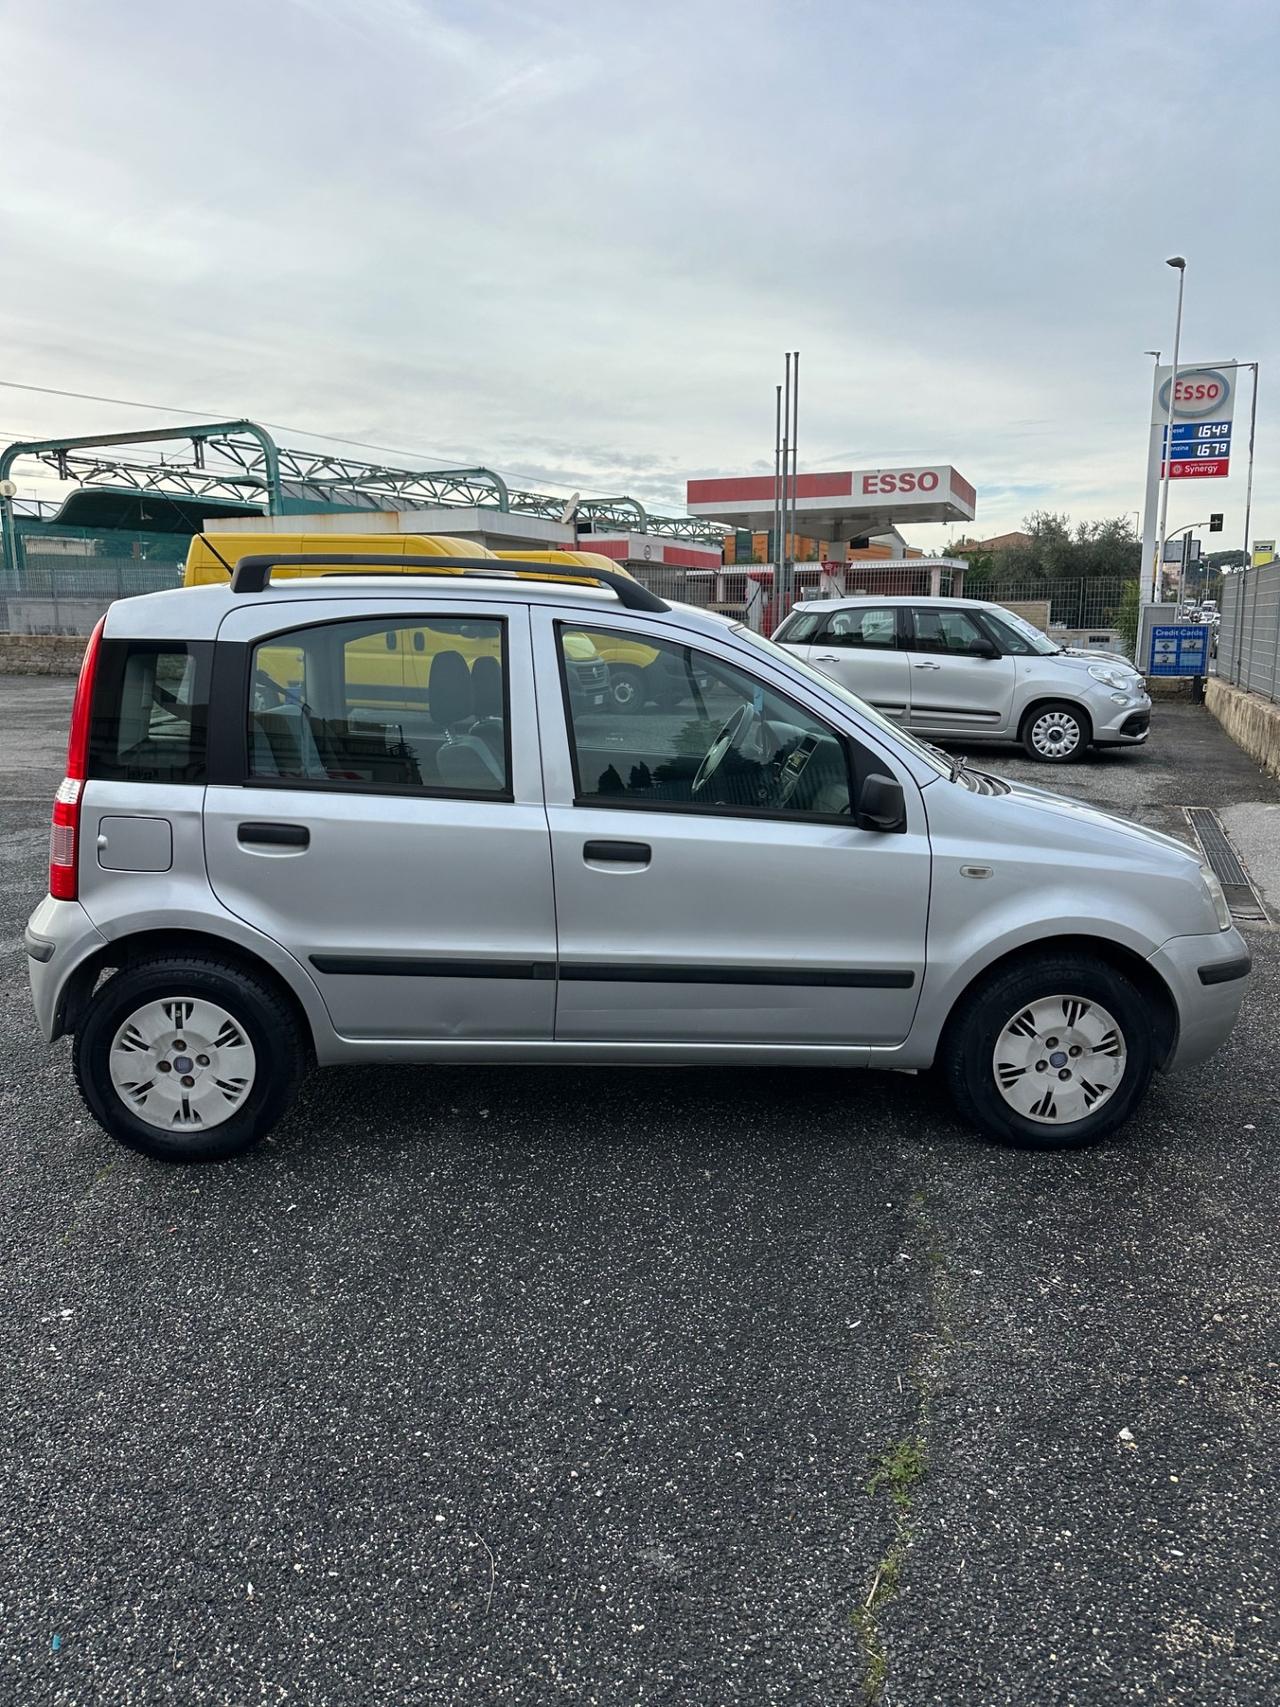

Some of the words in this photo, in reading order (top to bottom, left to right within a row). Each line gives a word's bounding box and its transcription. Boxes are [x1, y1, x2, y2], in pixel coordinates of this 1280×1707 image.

[1175, 382, 1218, 400] ESSO
[1185, 465, 1218, 474] Synergy
[863, 472, 938, 495] ESSO
[1156, 628, 1179, 636] Credit
[1180, 628, 1203, 636] Cards
